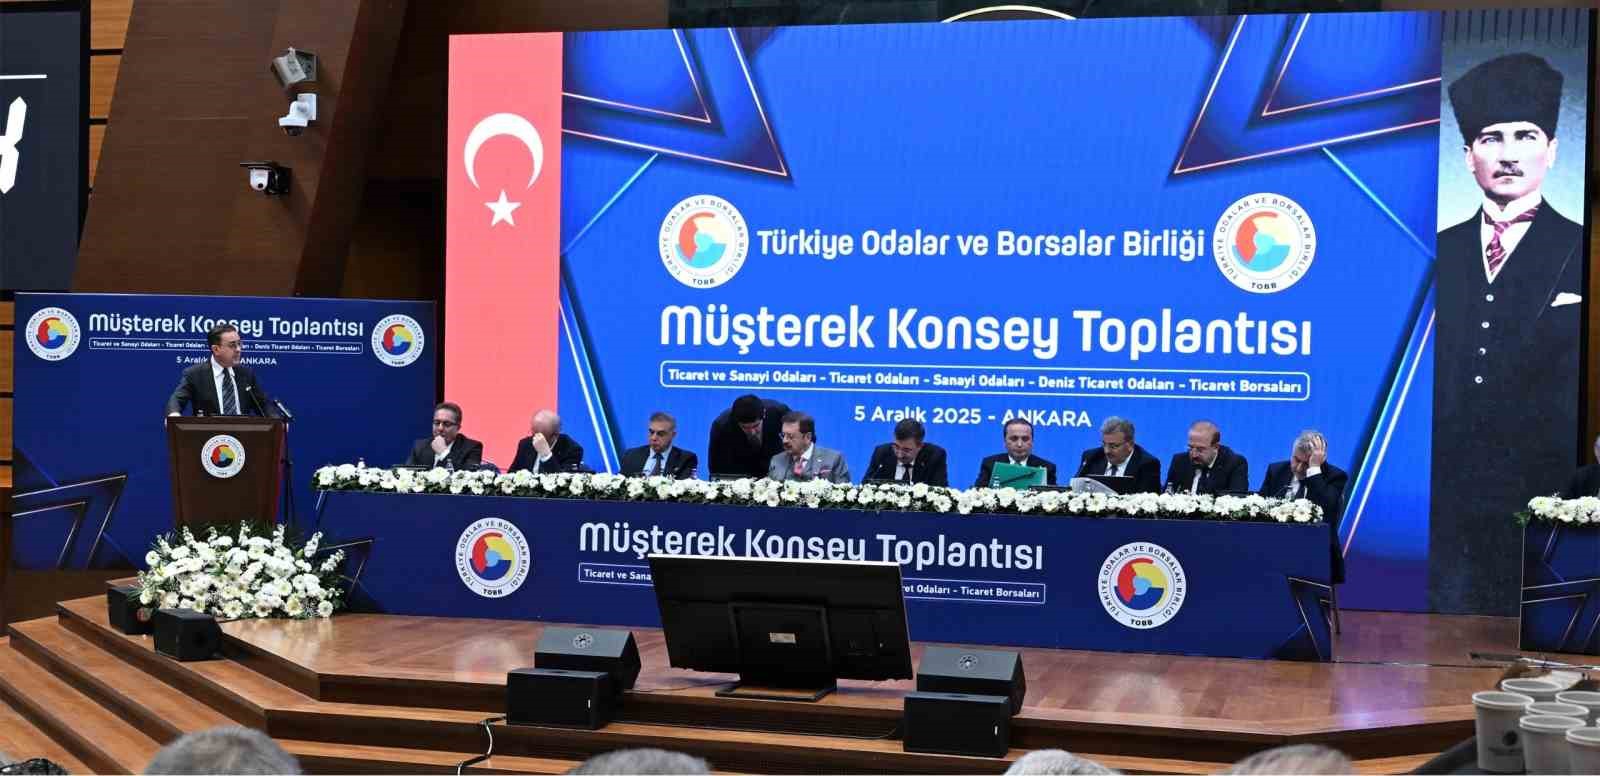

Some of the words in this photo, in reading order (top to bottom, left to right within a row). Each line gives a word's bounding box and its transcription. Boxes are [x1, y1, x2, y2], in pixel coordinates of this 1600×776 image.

[756, 228, 854, 260] Türkiye
[861, 228, 951, 256] Odalar
[956, 234, 989, 256] ve
[997, 228, 1116, 257] Borsalar
[1123, 229, 1205, 262] Birliği
[89, 313, 186, 336] Müşterek
[268, 316, 364, 339] Toplantısı
[660, 303, 875, 355] Müşterek
[888, 307, 1059, 360] Konsey
[1072, 308, 1312, 361] Toplantısı
[667, 368, 710, 381] Ticaret
[711, 371, 727, 382] ve
[728, 369, 770, 385] Sanayi
[772, 370, 817, 383] Odaları
[828, 371, 872, 385] Ticaret
[874, 372, 920, 385] Odaları
[932, 373, 976, 389] Sanayi
[978, 374, 1025, 388] Odaları
[1038, 375, 1076, 389] Deniz
[1077, 376, 1124, 390] Ticaret
[1126, 377, 1175, 391] Odaları
[1188, 378, 1236, 392] Ticaret
[1239, 379, 1302, 393] Borsaları
[853, 405, 866, 422] 5
[870, 404, 927, 424] Aralık
[932, 407, 982, 425] 2025
[1002, 407, 1093, 428] ANKARA
[579, 521, 737, 560] Müşterek
[874, 533, 1043, 571] Toplantısı
[583, 568, 615, 579] Ticaret
[616, 572, 628, 580] ve
[629, 571, 652, 581] Sana
[916, 584, 951, 594] Odaları
[959, 586, 994, 596] Ticaret
[995, 587, 1040, 598] Borsaları
